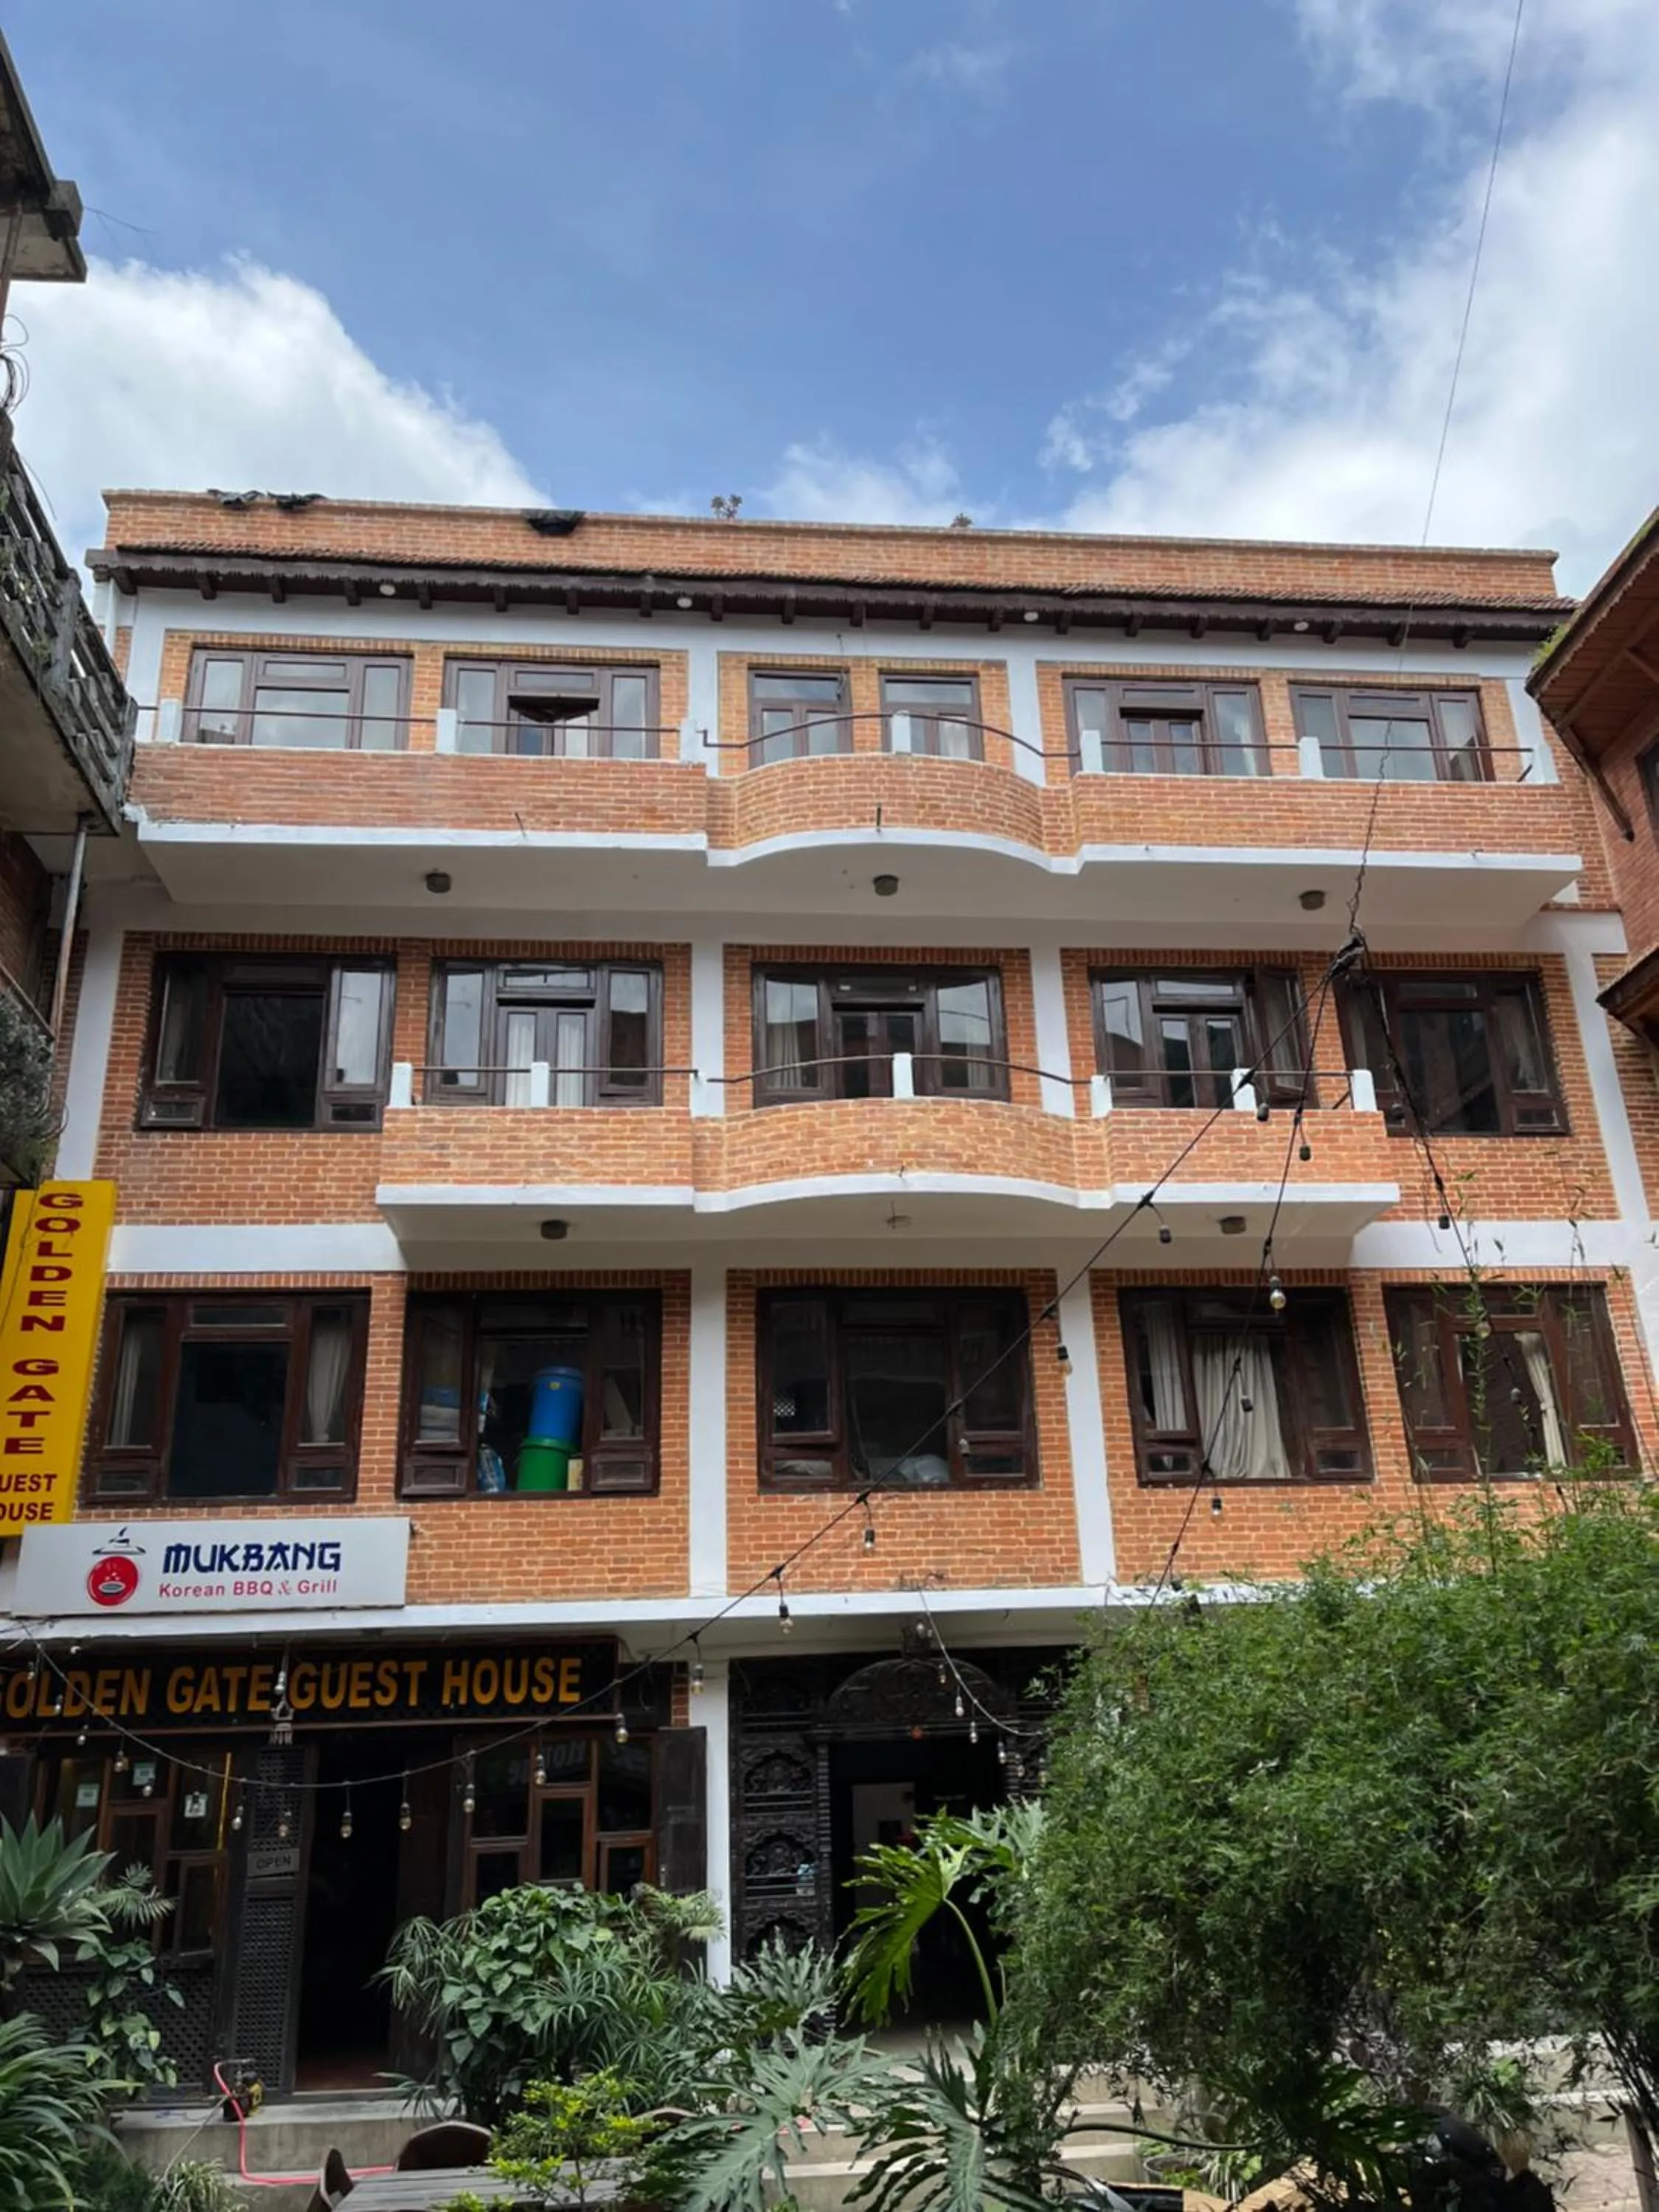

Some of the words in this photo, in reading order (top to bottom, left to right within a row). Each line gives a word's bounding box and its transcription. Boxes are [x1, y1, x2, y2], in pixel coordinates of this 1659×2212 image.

[20, 1192, 83, 1332] GOLDEN
[4, 1359, 59, 1455] GATE
[0, 1473, 58, 1492] UEST
[162, 1541, 341, 1574] MUKBANG
[159, 1582, 226, 1599] Korean
[233, 1581, 274, 1598] BBQ
[297, 1579, 337, 1594] Grill
[0, 1667, 153, 1719] OLDEN
[166, 1663, 274, 1715] GATE
[289, 1660, 428, 1710] GUEST
[442, 1657, 582, 1705] HOUSE
[256, 1854, 291, 1870] OPEN
